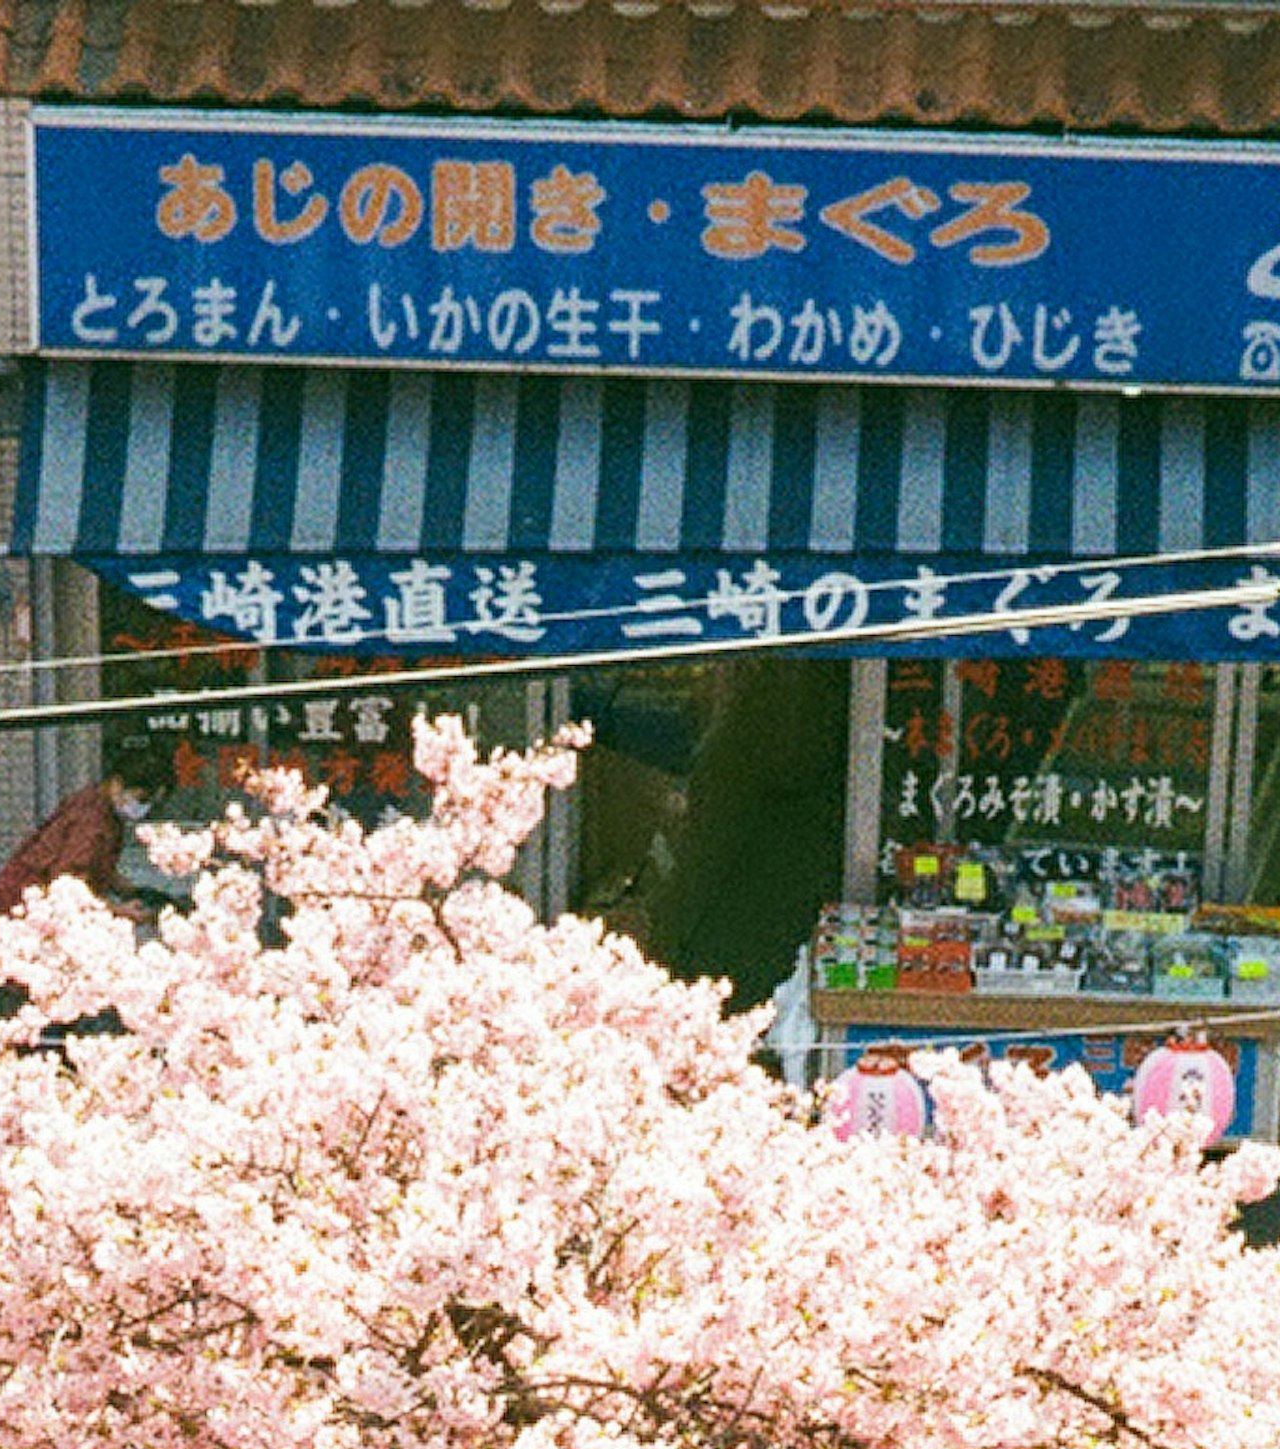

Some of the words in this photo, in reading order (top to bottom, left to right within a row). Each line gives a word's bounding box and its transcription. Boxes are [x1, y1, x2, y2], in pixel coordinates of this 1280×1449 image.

[125, 559, 544, 647] 三崎港直送
